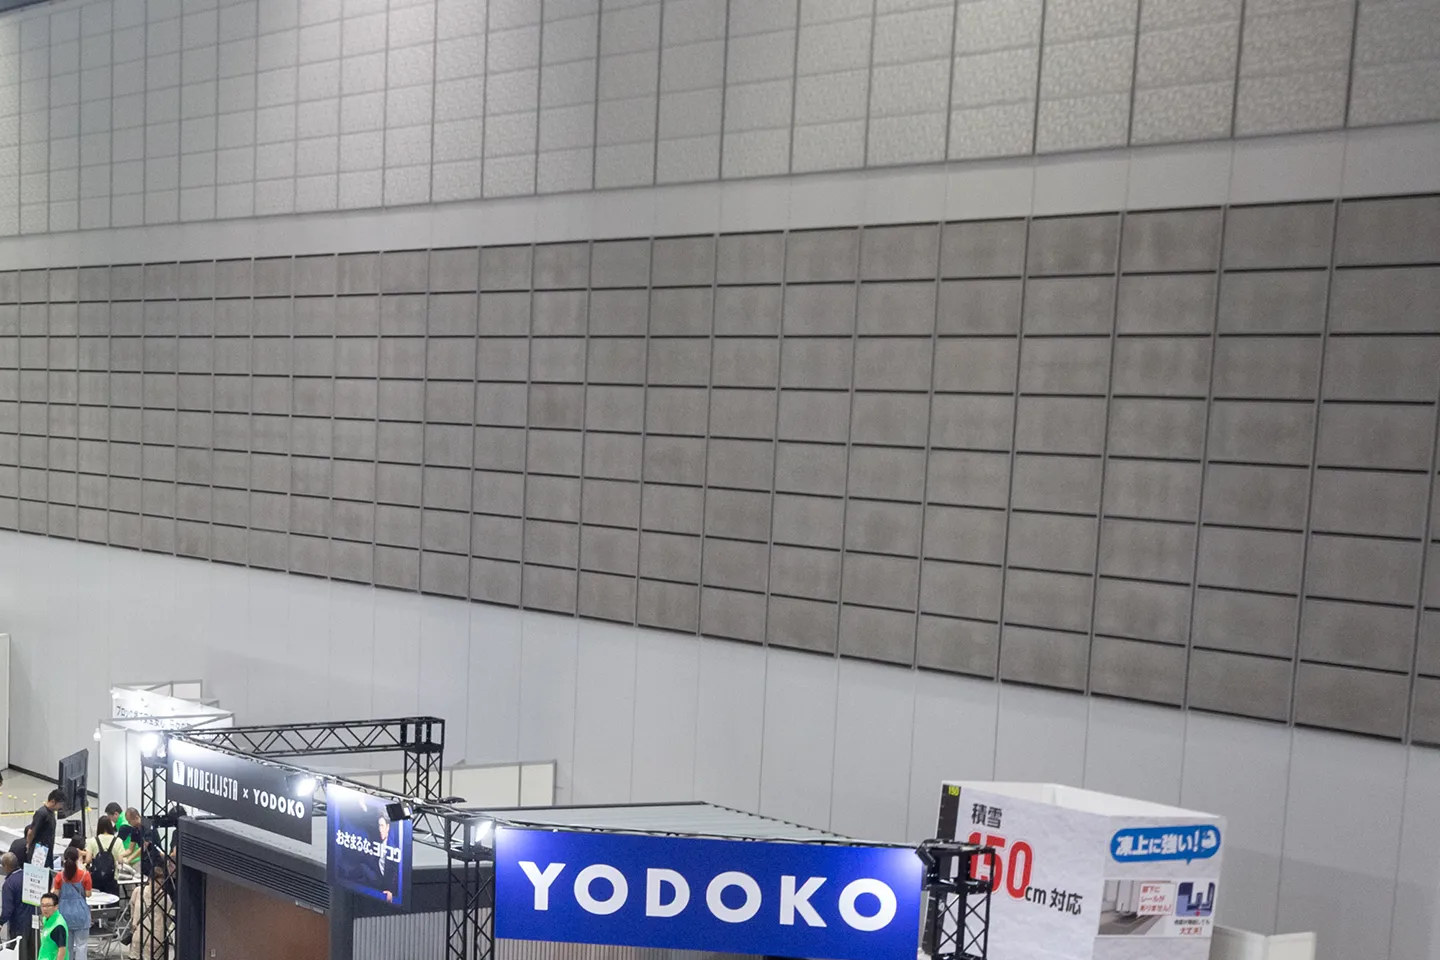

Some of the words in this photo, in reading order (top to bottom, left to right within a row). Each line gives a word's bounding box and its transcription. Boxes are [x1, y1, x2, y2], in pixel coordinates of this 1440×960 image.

[186, 766, 239, 801] MODELLISTA
[253, 788, 305, 818] YODOKO
[971, 803, 1003, 829] 積雪
[518, 861, 897, 931] YODOKO
[968, 831, 1033, 899] 150
[1025, 886, 1047, 905] cm
[1050, 888, 1083, 915] 対応
